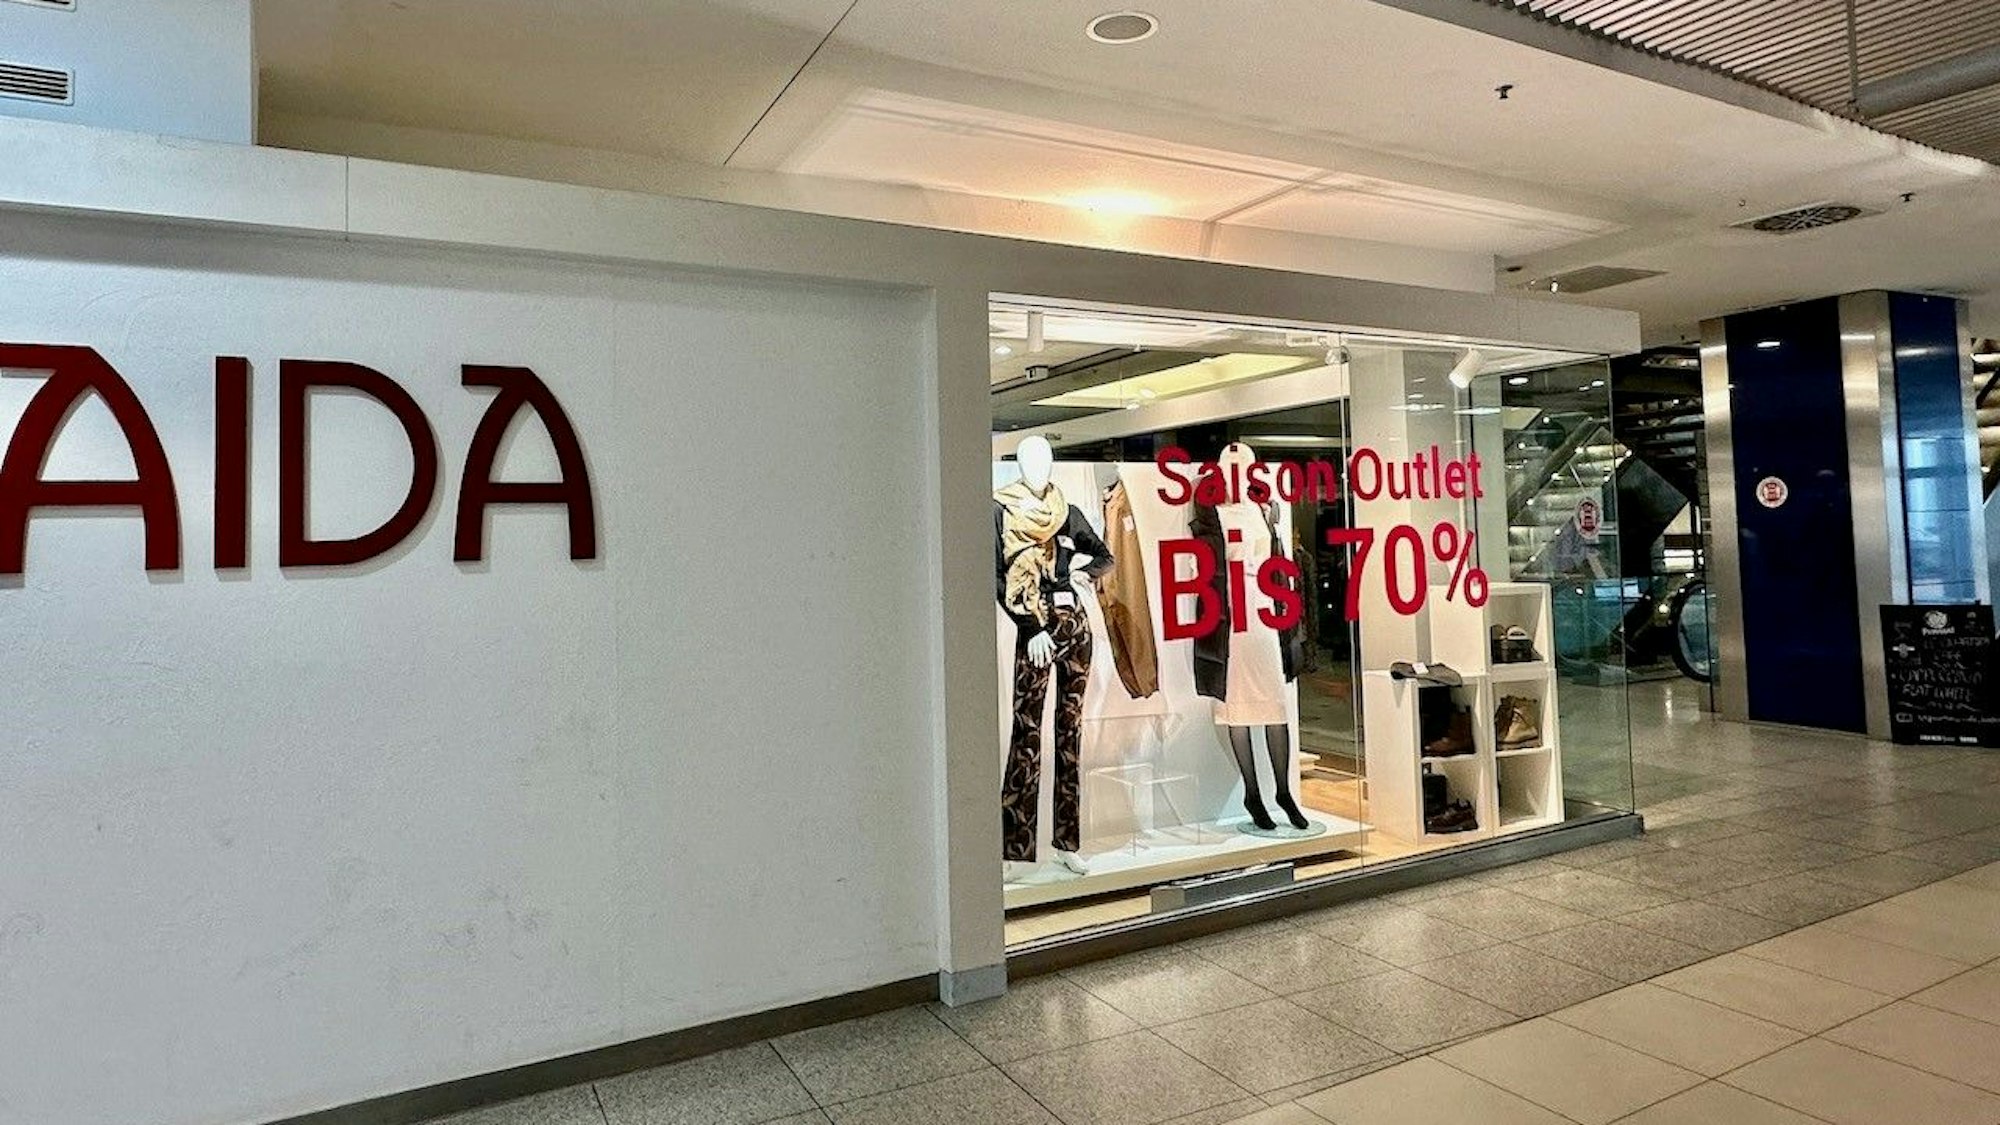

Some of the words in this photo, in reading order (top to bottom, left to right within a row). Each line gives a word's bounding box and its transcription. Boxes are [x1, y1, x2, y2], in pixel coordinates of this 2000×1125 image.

[0, 343, 596, 574] AIDA
[1157, 444, 1336, 506] Saison
[1350, 446, 1482, 501] Outlet
[1158, 529, 1303, 641] Bis
[1326, 521, 1489, 621] 70%
